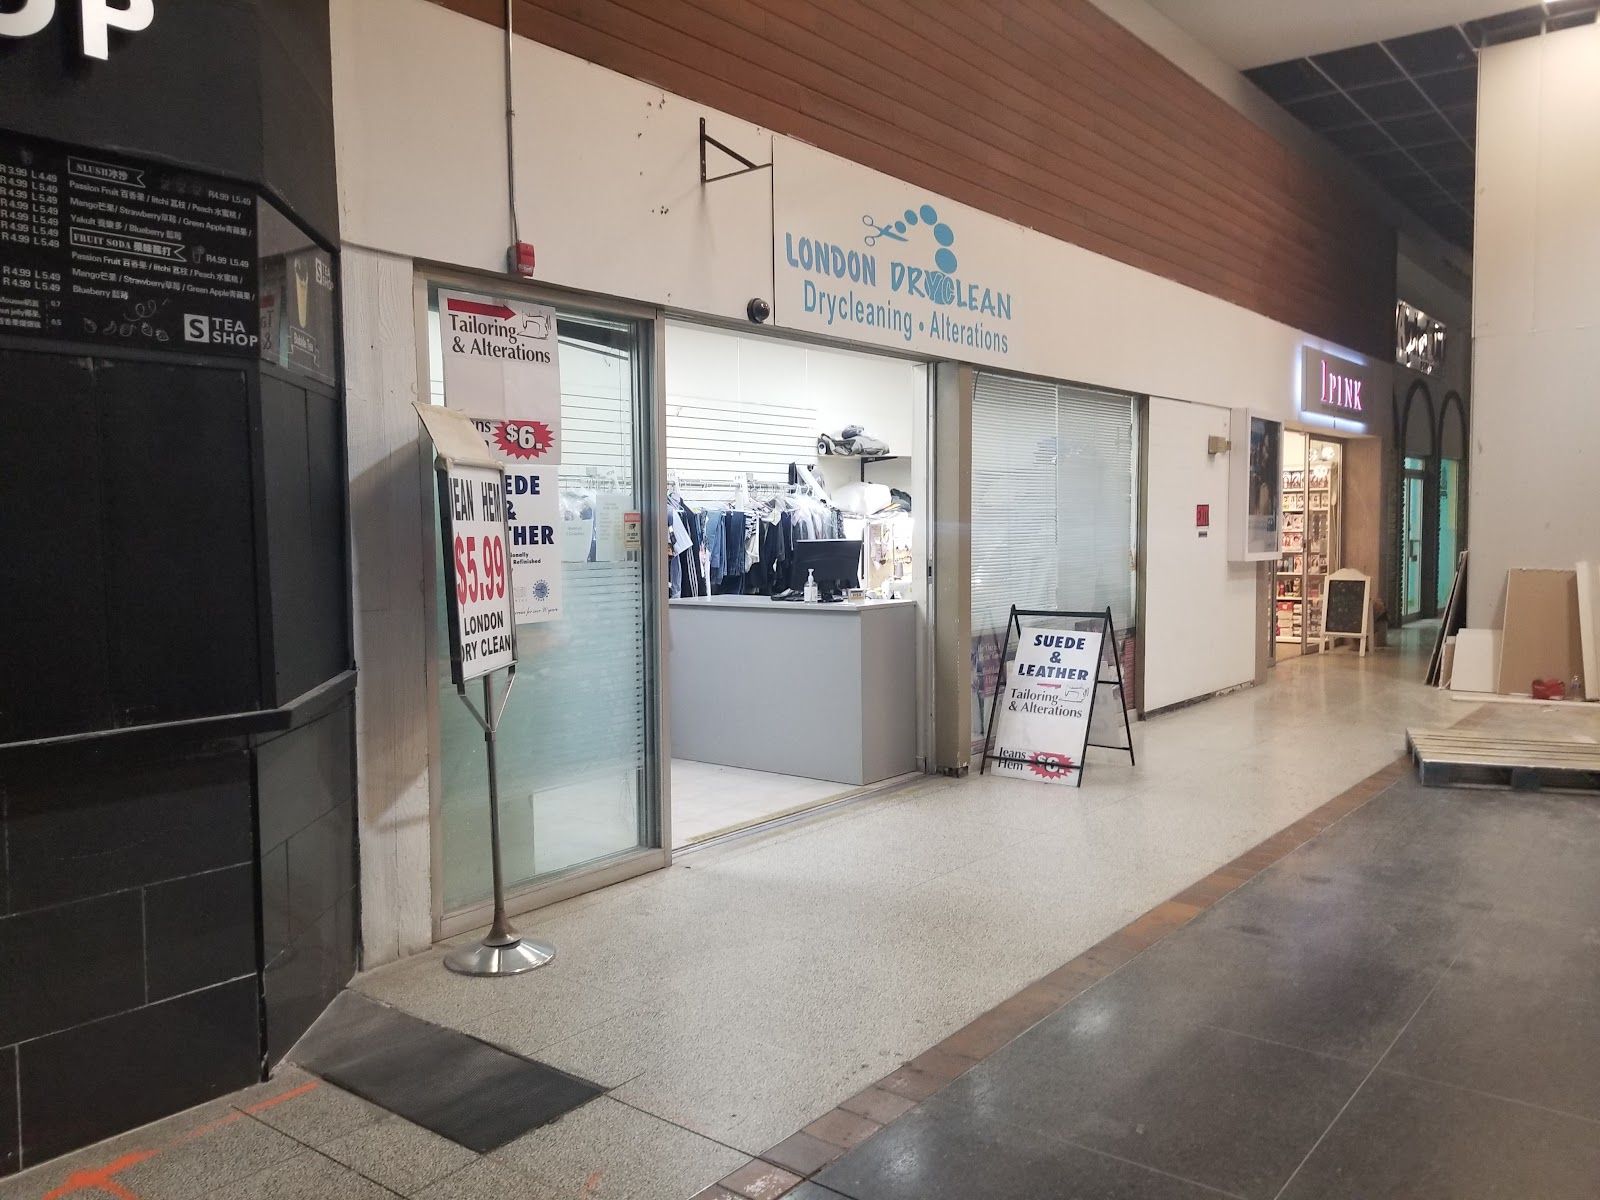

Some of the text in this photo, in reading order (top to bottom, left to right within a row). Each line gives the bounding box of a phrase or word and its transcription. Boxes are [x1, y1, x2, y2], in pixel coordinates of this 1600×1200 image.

[70, 180, 100, 192] Passion
[106, 239, 131, 250] SODA
[72, 251, 102, 263] Passion
[786, 232, 876, 287] LONDON
[212, 317, 246, 333] TEA
[804, 280, 1008, 354] Drycleaning Alterations
[448, 314, 518, 344] Tailoring
[212, 331, 258, 347] SHOP
[452, 336, 551, 363] & Alterations
[455, 532, 504, 614] $5.99
[464, 611, 504, 636] LONDON
[481, 634, 510, 656] CLEAN
[1034, 635, 1086, 650] SUEDE
[1050, 651, 1061, 663] &
[1018, 664, 1088, 680] LEATHER
[1011, 688, 1058, 706] Tailoring
[1008, 701, 1082, 718] & Alterations
[999, 747, 1026, 759] Jeans
